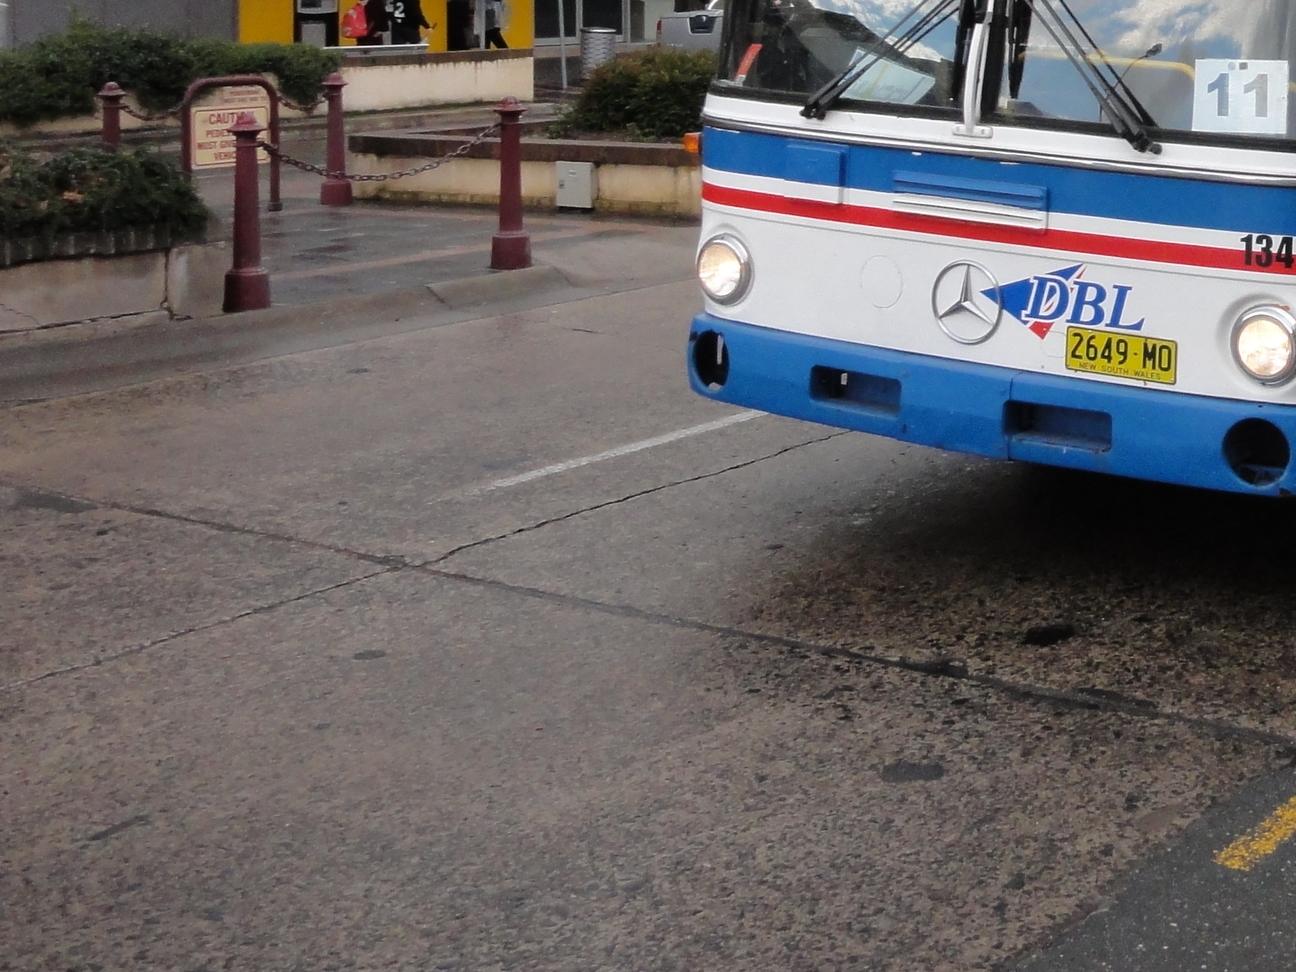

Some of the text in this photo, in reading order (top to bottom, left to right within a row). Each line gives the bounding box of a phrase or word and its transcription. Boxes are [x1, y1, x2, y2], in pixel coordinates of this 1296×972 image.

[394, 2, 406, 18] 2
[1207, 73, 1268, 118] 11
[1240, 234, 1294, 269] 134
[1024, 275, 1146, 331] DBL
[1071, 332, 1128, 365] 2649
[1079, 362, 1161, 380] NEW SOUTH WALES
